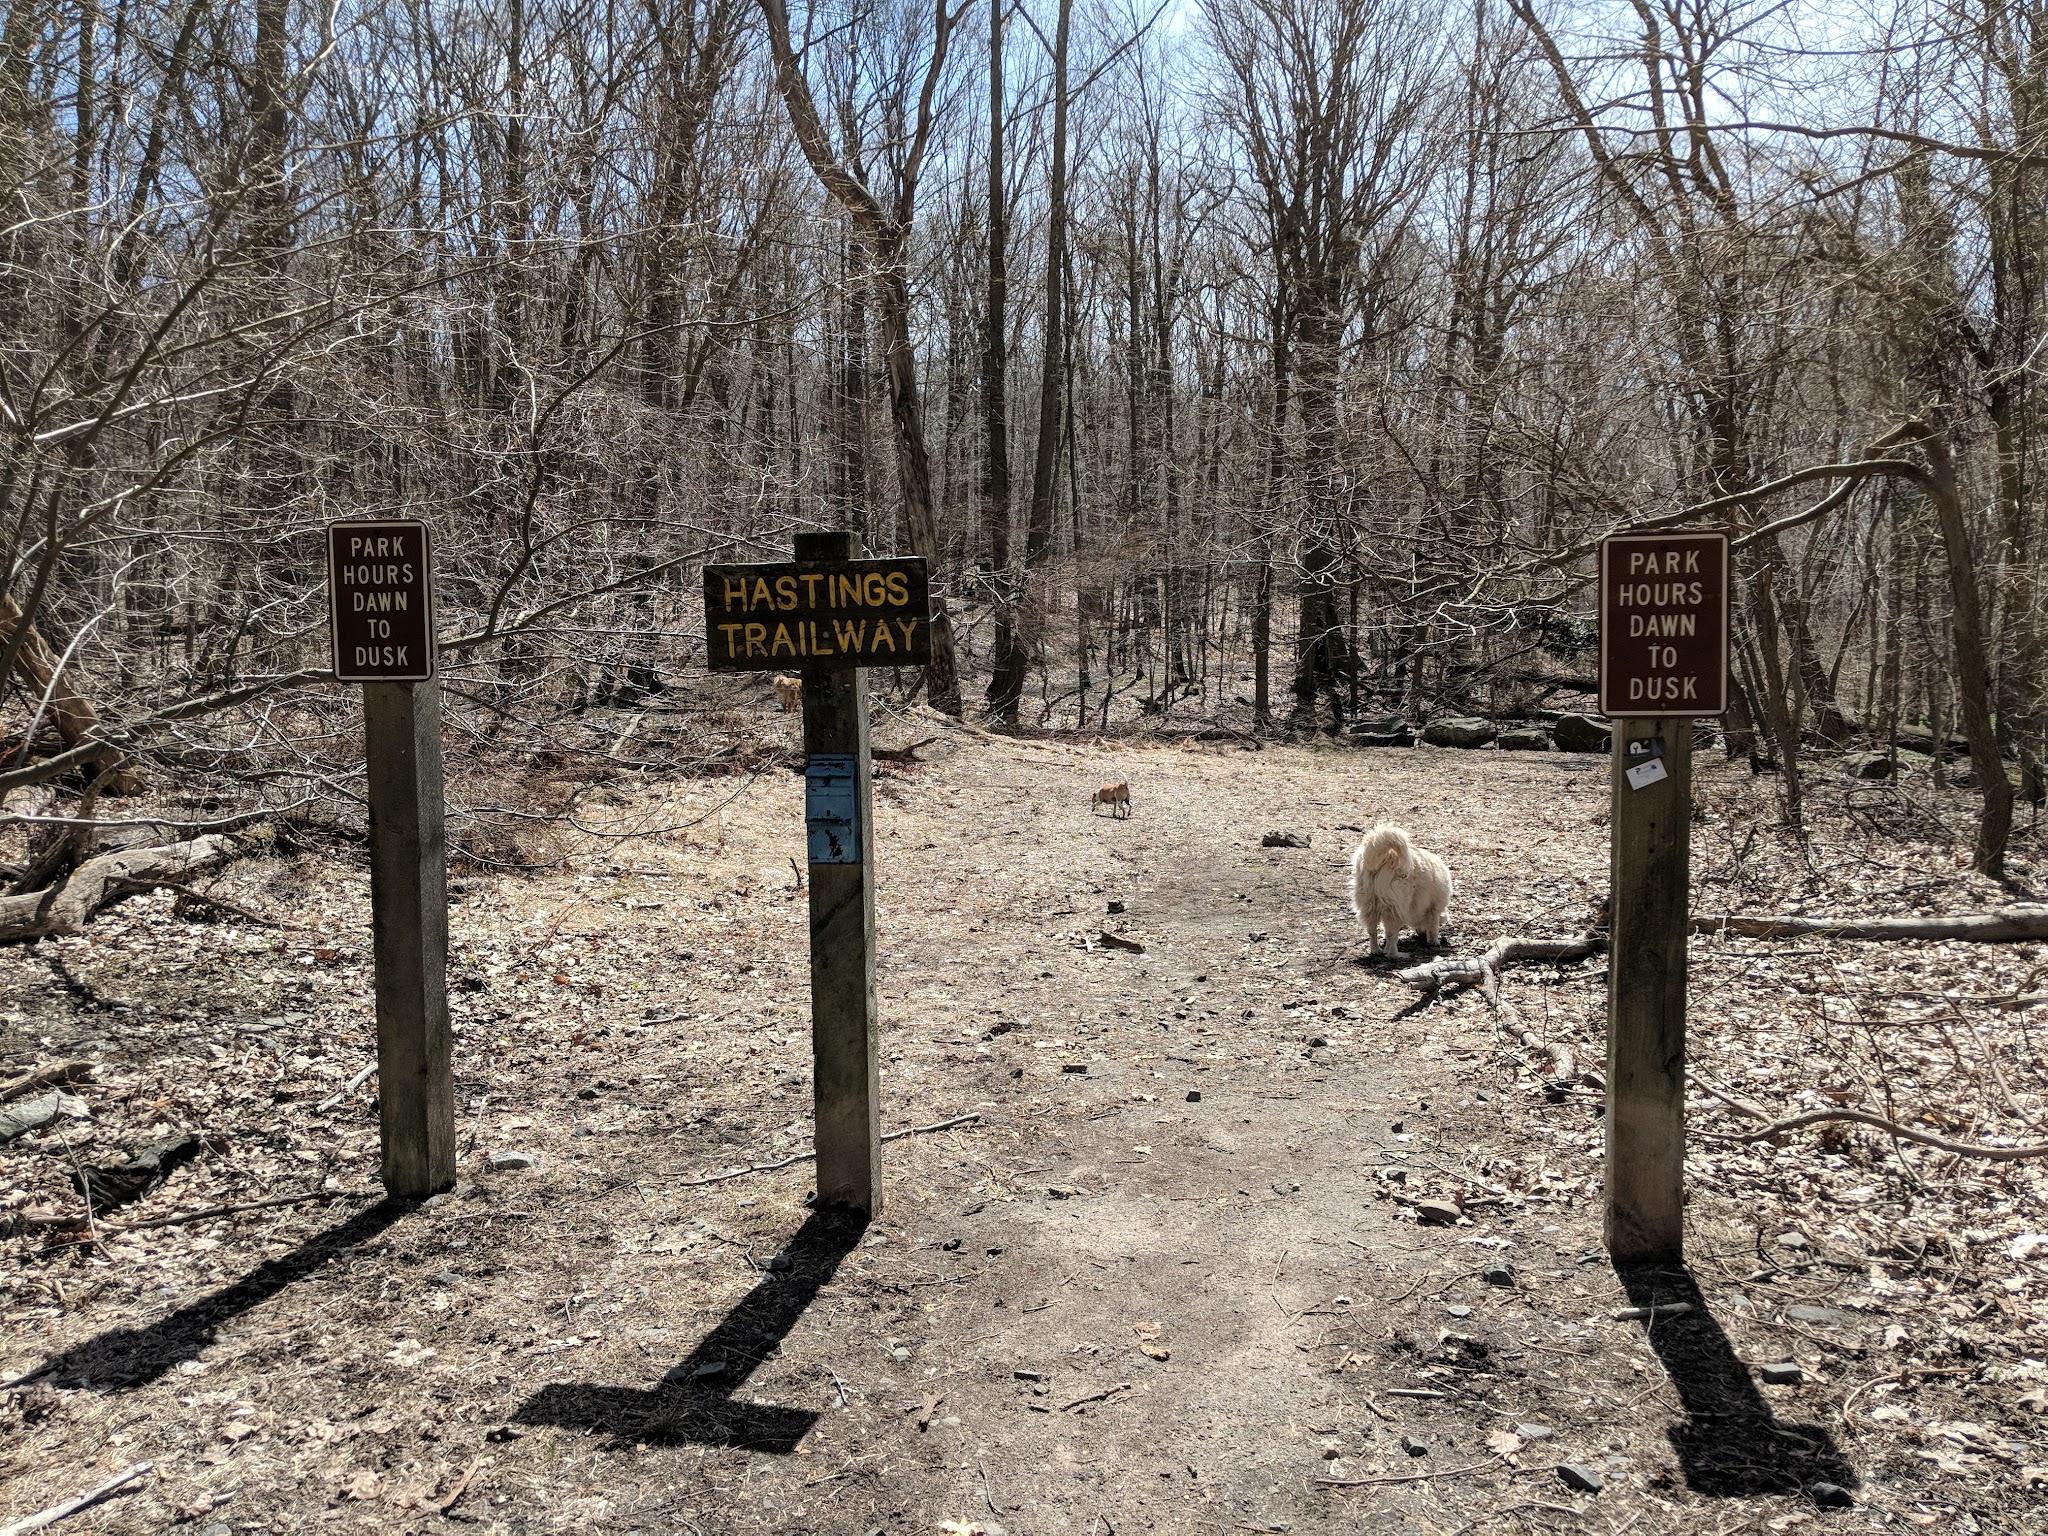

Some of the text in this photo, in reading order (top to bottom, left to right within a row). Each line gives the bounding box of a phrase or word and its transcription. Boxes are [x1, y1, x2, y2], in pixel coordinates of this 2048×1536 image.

[351, 536, 404, 557] PARK
[343, 563, 414, 585] HOURS
[1630, 550, 1700, 575] PARK
[353, 591, 408, 612] DAWN
[723, 571, 909, 612] HASTINGS
[1619, 582, 1703, 606] HOURS
[367, 619, 391, 639] TO
[1630, 614, 1696, 637] DAWN
[717, 617, 918, 659] TRAILWAY
[355, 646, 409, 667] DUSK
[1648, 645, 1678, 669] TO
[1629, 676, 1698, 700] DUSK
